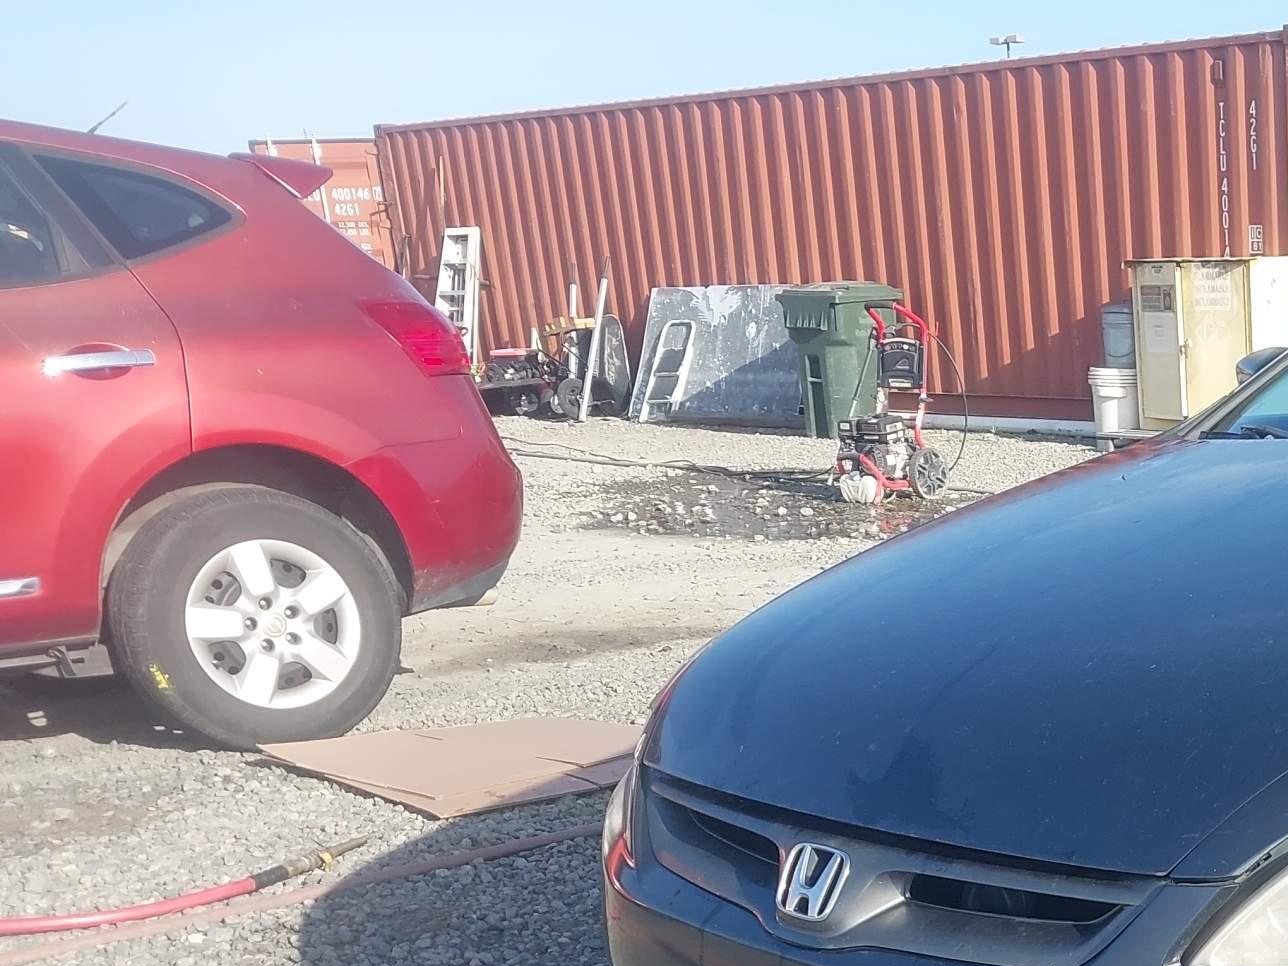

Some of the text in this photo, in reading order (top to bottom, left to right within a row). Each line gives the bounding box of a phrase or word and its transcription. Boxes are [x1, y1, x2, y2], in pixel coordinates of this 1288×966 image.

[1218, 102, 1227, 171] TCLU
[1249, 100, 1257, 170] 42G1
[331, 186, 370, 200] 400146
